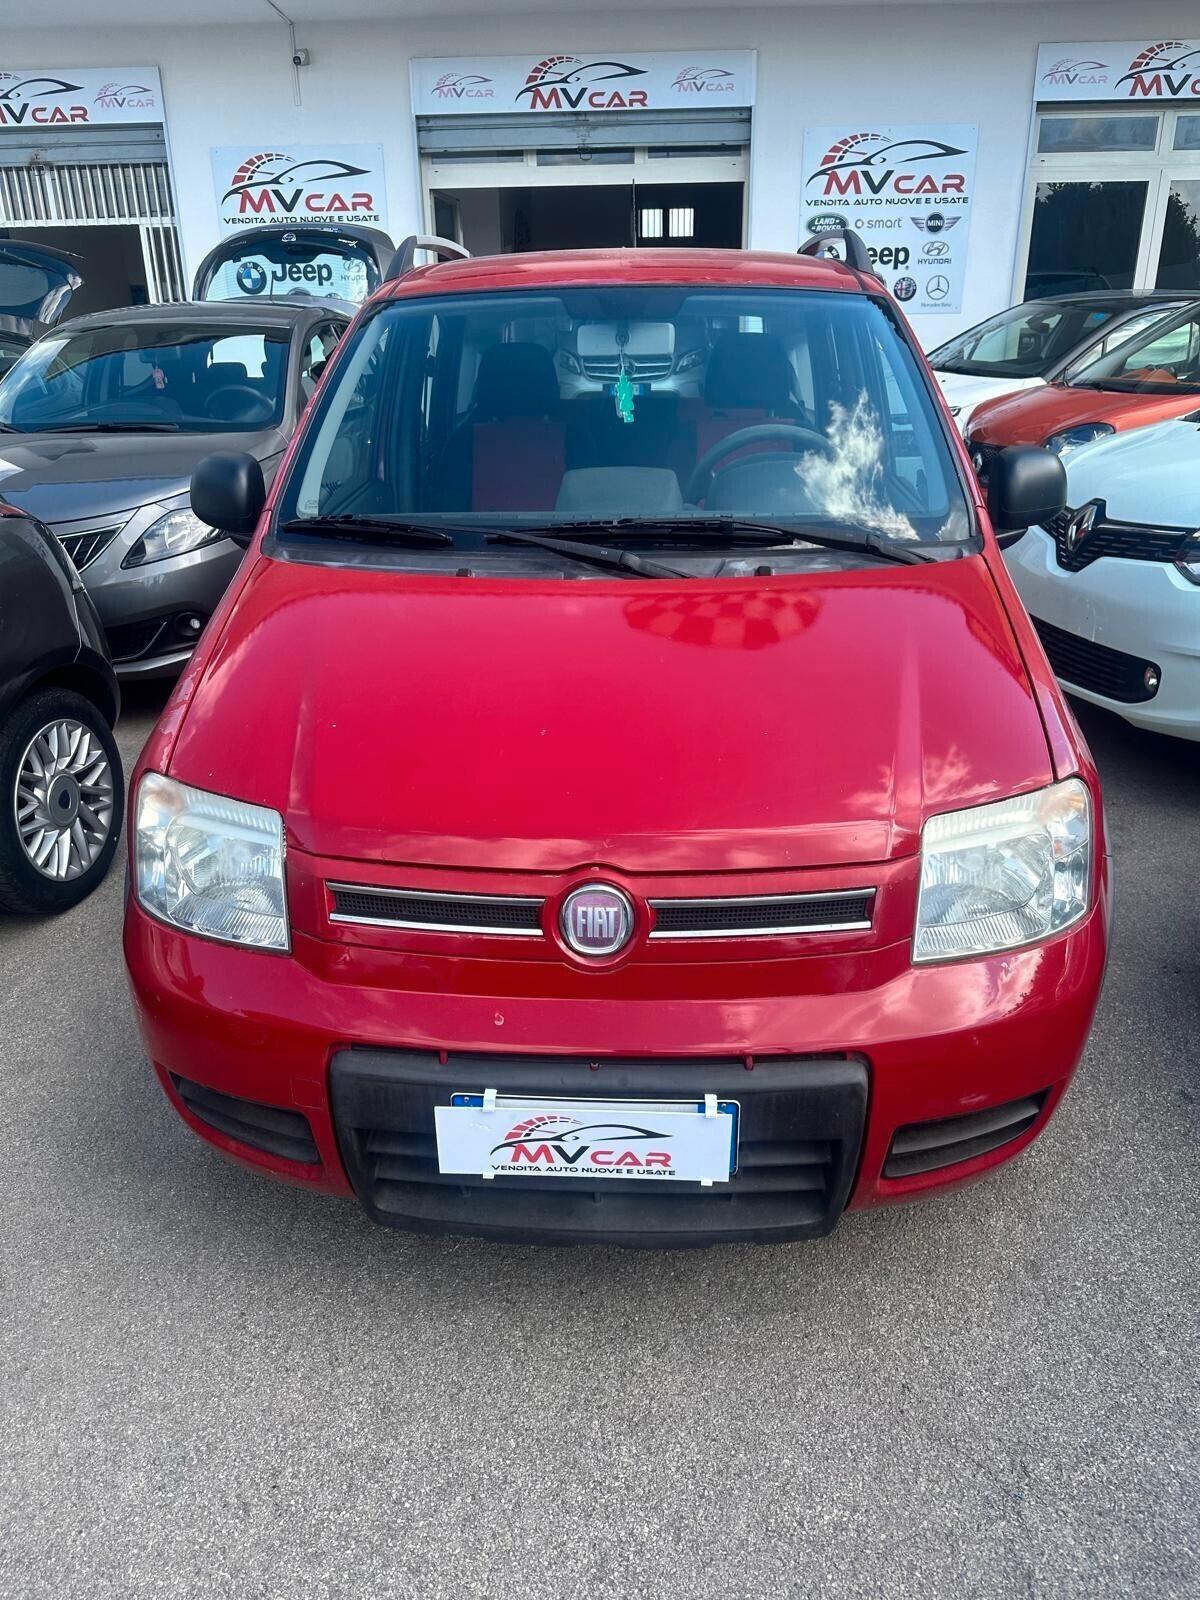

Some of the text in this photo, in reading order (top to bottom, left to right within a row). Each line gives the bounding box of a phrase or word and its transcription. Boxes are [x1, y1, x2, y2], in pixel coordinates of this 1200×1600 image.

[805, 199, 850, 207] VENDITA
[853, 198, 883, 206] AUTO
[885, 197, 922, 206] NUOVE
[934, 196, 969, 204] USATE
[300, 215, 335, 223] NUOVE
[346, 214, 380, 222] USATE
[814, 217, 835, 225] LAND
[866, 217, 902, 229] smart
[927, 220, 943, 228] MINI
[866, 246, 910, 270] eep
[271, 263, 333, 286] Jeep
[576, 905, 618, 938] FIAT
[491, 1164, 542, 1172] VENDITA
